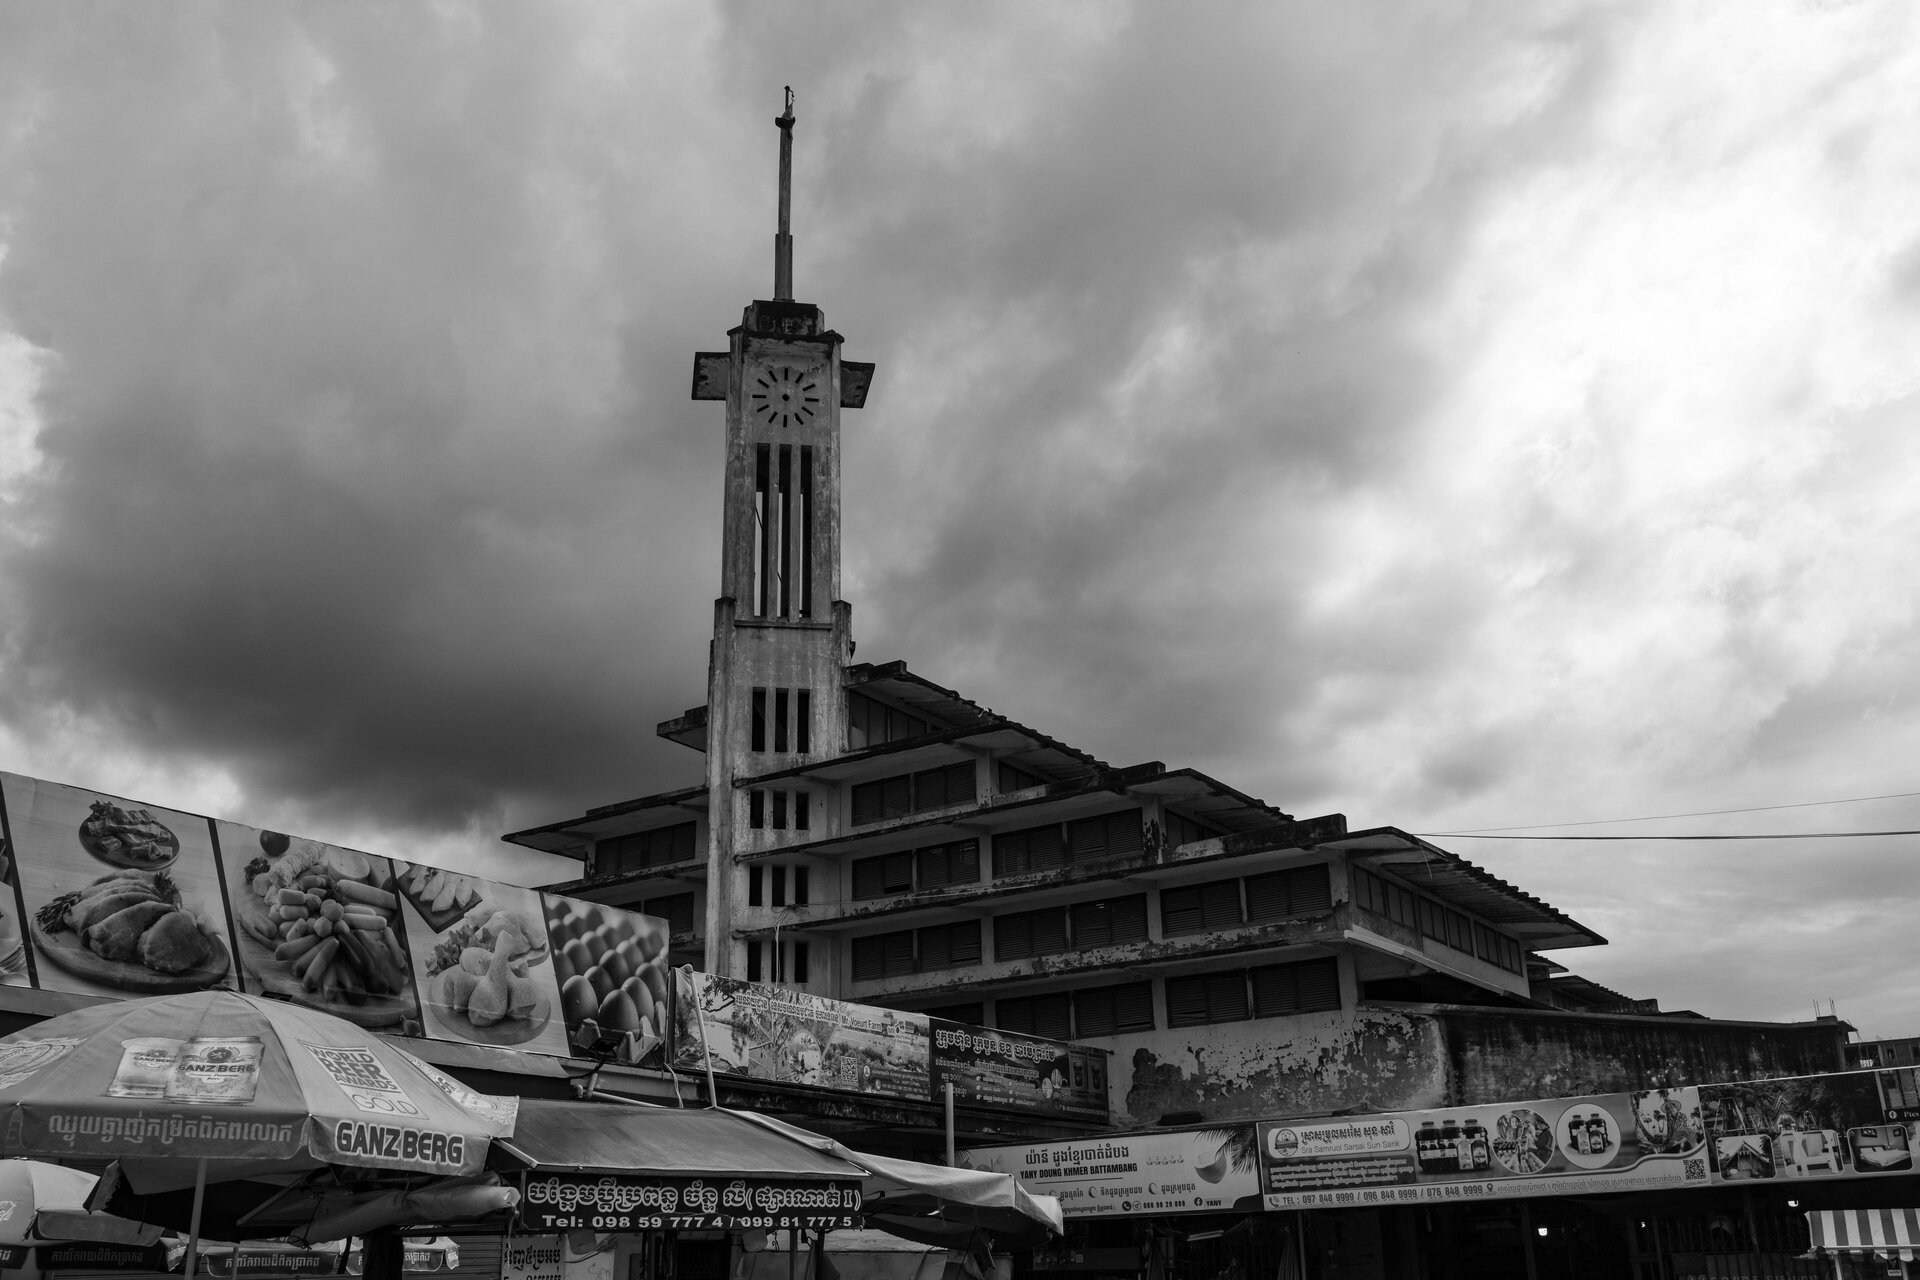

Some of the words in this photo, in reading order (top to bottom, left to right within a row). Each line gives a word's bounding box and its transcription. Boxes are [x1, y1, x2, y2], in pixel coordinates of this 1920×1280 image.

[307, 1047, 374, 1064] WORLD
[178, 1064, 254, 1073] GANZBERG
[317, 1057, 390, 1080] BEER
[333, 1073, 398, 1090] AWARDS
[352, 1093, 418, 1115] GOLD
[335, 1120, 465, 1166] GANZBERG
[1020, 1170, 1037, 1179] YANY
[1039, 1168, 1062, 1178] DOUNG
[1063, 1166, 1088, 1176] KHMER
[1090, 1163, 1138, 1175] BATTAMBANG
[1282, 1196, 1295, 1205] TEL
[1302, 1194, 1316, 1203] 097
[1319, 1193, 1333, 1203] 848
[1336, 1192, 1355, 1202] 9999
[1363, 1191, 1378, 1201] 096
[1380, 1190, 1395, 1200] 848
[1398, 1189, 1418, 1199] 9999
[1426, 1187, 1442, 1197] 076
[1445, 1186, 1460, 1196] 848
[1463, 1185, 1484, 1195] 9999
[541, 1214, 583, 1228] Tel:
[592, 1216, 631, 1228] 098
[638, 1216, 662, 1228] 59
[669, 1216, 705, 1228] 777
[711, 1216, 723, 1228] 4
[741, 1216, 773, 1227] 099
[780, 1216, 799, 1227] 81
[806, 1216, 837, 1227] 777
[842, 1216, 852, 1227] 5
